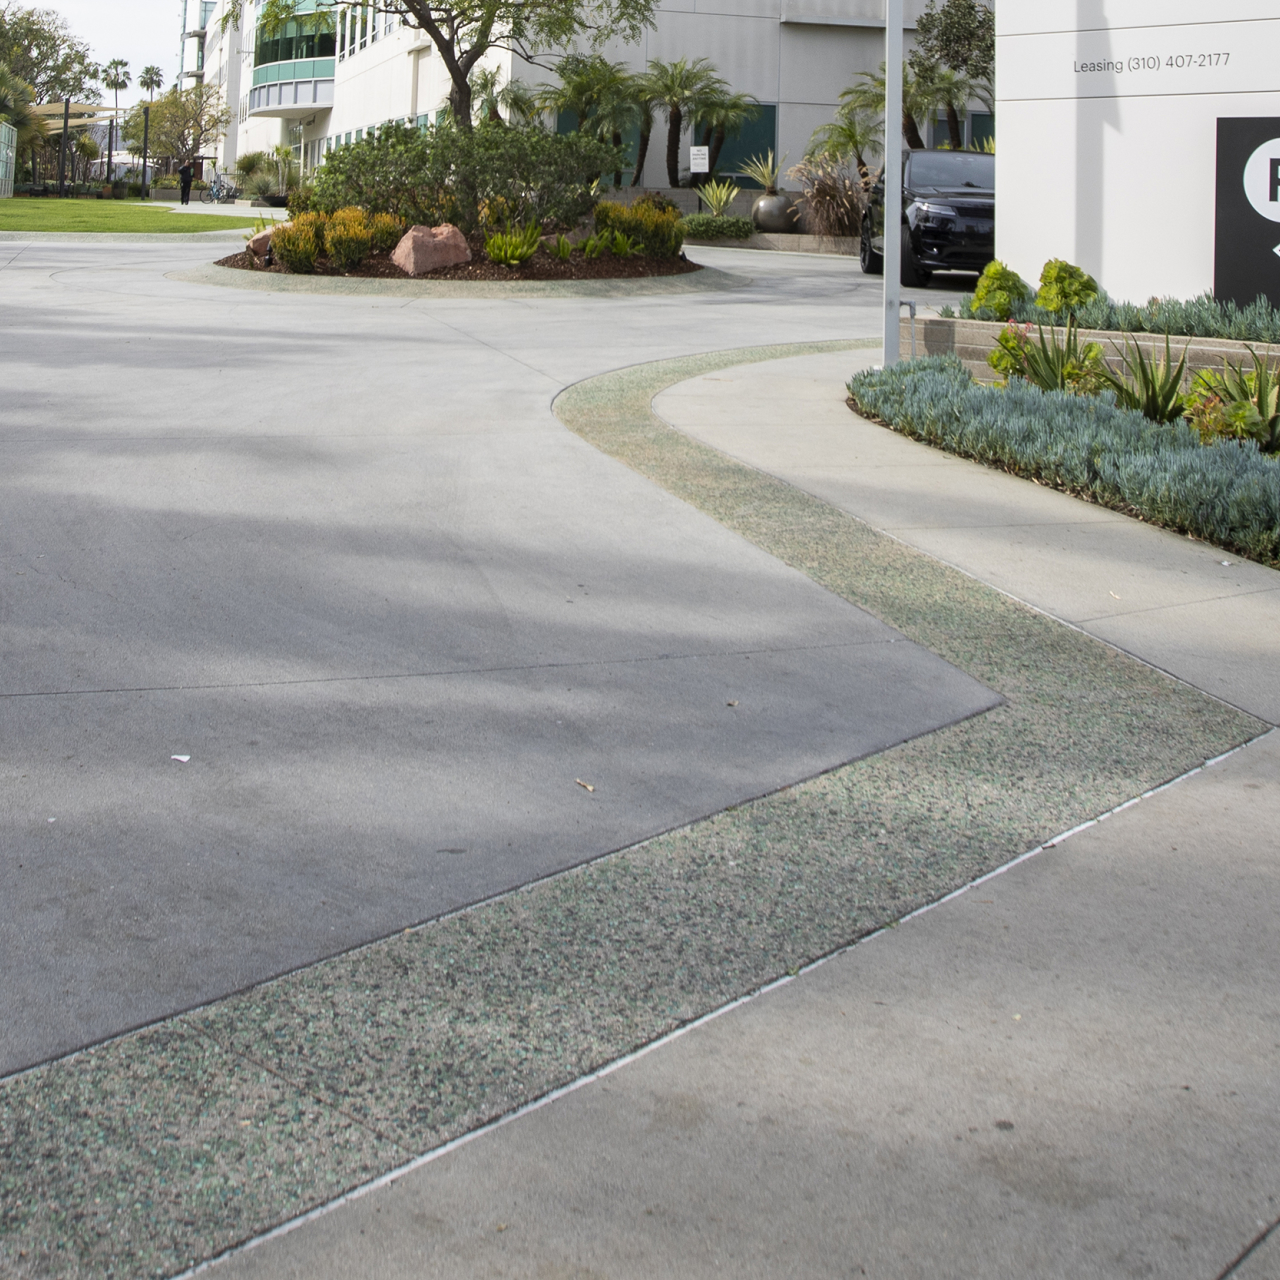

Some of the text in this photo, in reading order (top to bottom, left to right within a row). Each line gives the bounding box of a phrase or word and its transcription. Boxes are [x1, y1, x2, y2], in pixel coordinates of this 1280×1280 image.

[1073, 52, 1231, 73] Leasing (310) 407-2177
